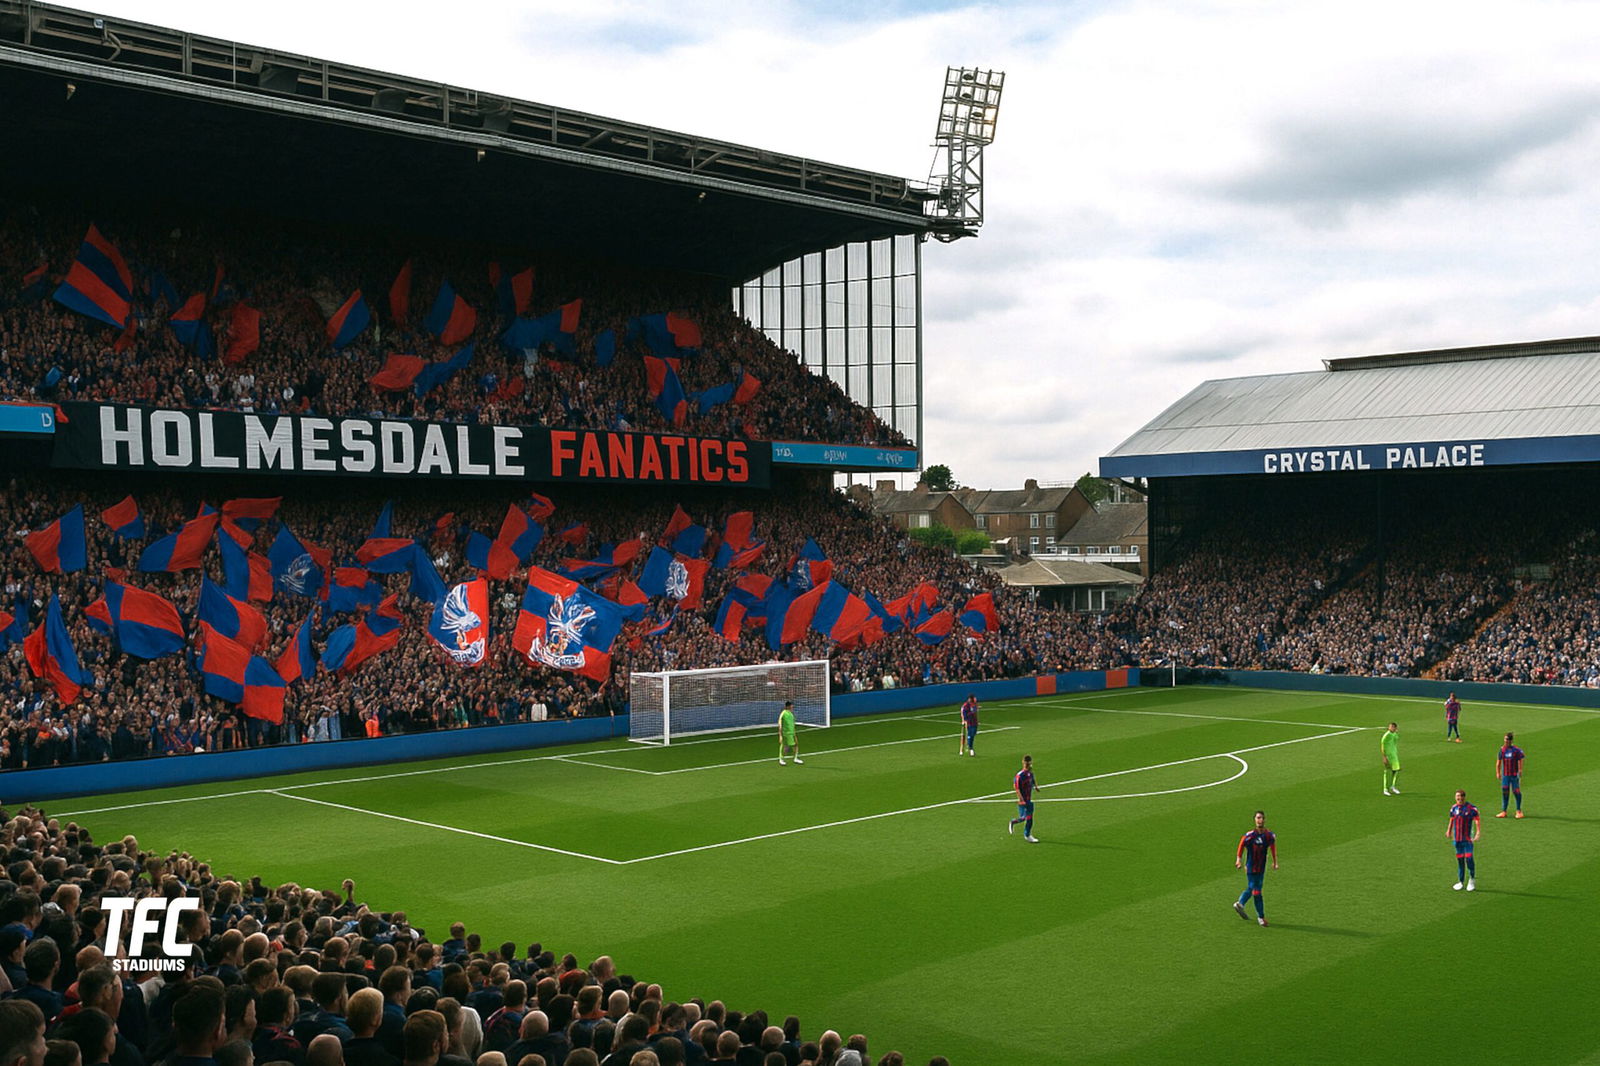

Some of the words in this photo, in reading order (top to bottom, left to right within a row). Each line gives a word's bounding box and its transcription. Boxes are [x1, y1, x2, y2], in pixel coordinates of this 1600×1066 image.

[100, 405, 525, 476] HOLMESDALE
[550, 430, 749, 482] FANATICS
[1264, 449, 1370, 473] CRYSTAL
[1386, 444, 1484, 469] PALACE
